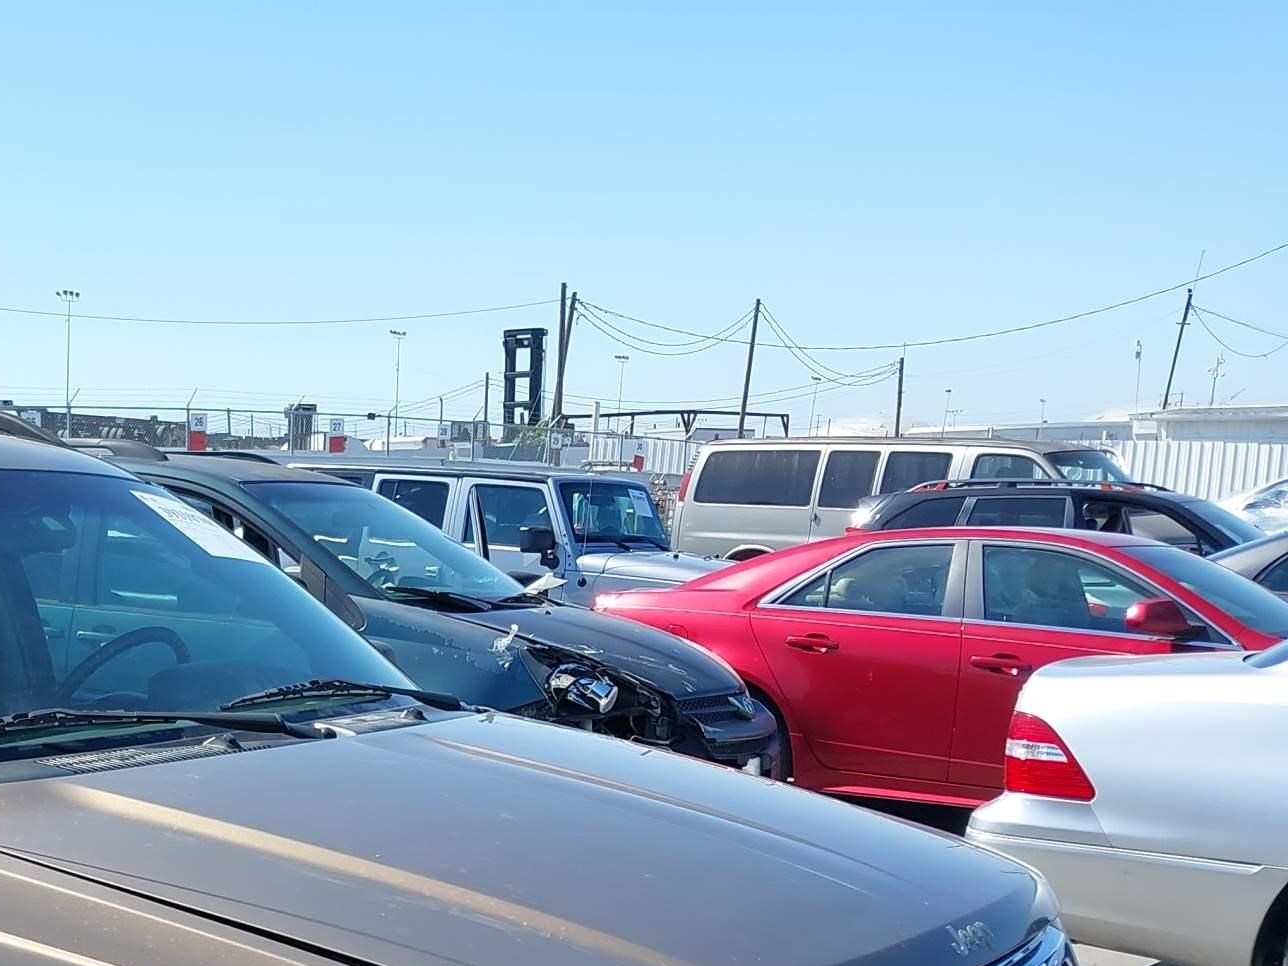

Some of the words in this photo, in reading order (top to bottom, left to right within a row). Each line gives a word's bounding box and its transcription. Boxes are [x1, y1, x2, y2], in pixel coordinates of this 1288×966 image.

[194, 416, 204, 427] 26
[332, 422, 342, 432] 27
[945, 921, 993, 957] Jeep
